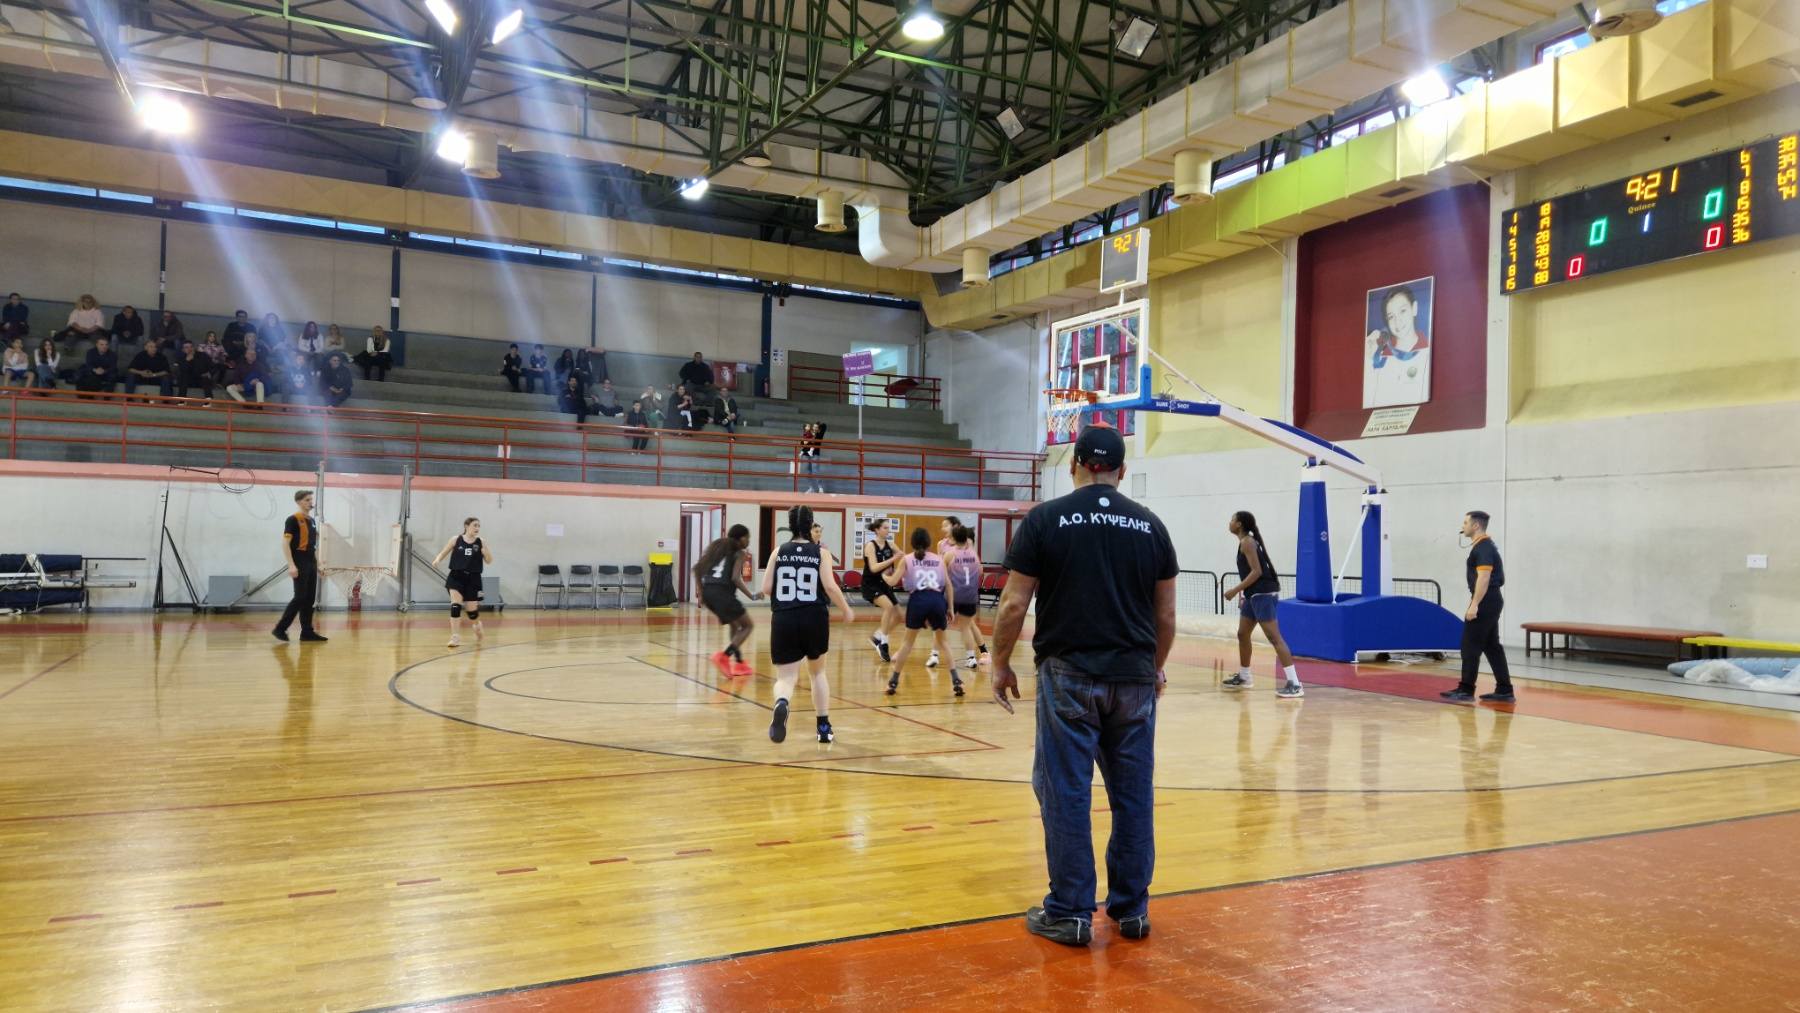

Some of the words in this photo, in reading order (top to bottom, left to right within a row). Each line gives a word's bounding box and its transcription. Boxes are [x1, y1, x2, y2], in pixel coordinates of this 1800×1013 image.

[1740, 150, 1750, 164] 6
[1741, 164, 1750, 177] 7
[1777, 168, 1797, 186] 69
[1626, 167, 1679, 200] 9:21
[1740, 180, 1751, 195] 8
[1703, 190, 1722, 219] 0
[1512, 211, 1518, 223] 1
[1643, 212, 1650, 232] 1
[1732, 211, 1750, 228] 35
[1508, 225, 1517, 236] 4
[1535, 230, 1550, 244] 28
[1589, 219, 1607, 245] 0
[1706, 227, 1721, 248] 0
[1508, 238, 1517, 251] 5
[1510, 251, 1517, 262] 7
[1508, 264, 1516, 277] 8
[1569, 258, 1582, 277] 0
[1534, 270, 1549, 285] 88
[1059, 513, 1087, 528] Α.Ο.
[1090, 513, 1152, 534] ΚΥΨΕΛΗΣ
[776, 566, 819, 602] 69
[915, 569, 940, 590] 28
[963, 566, 970, 586] 1
